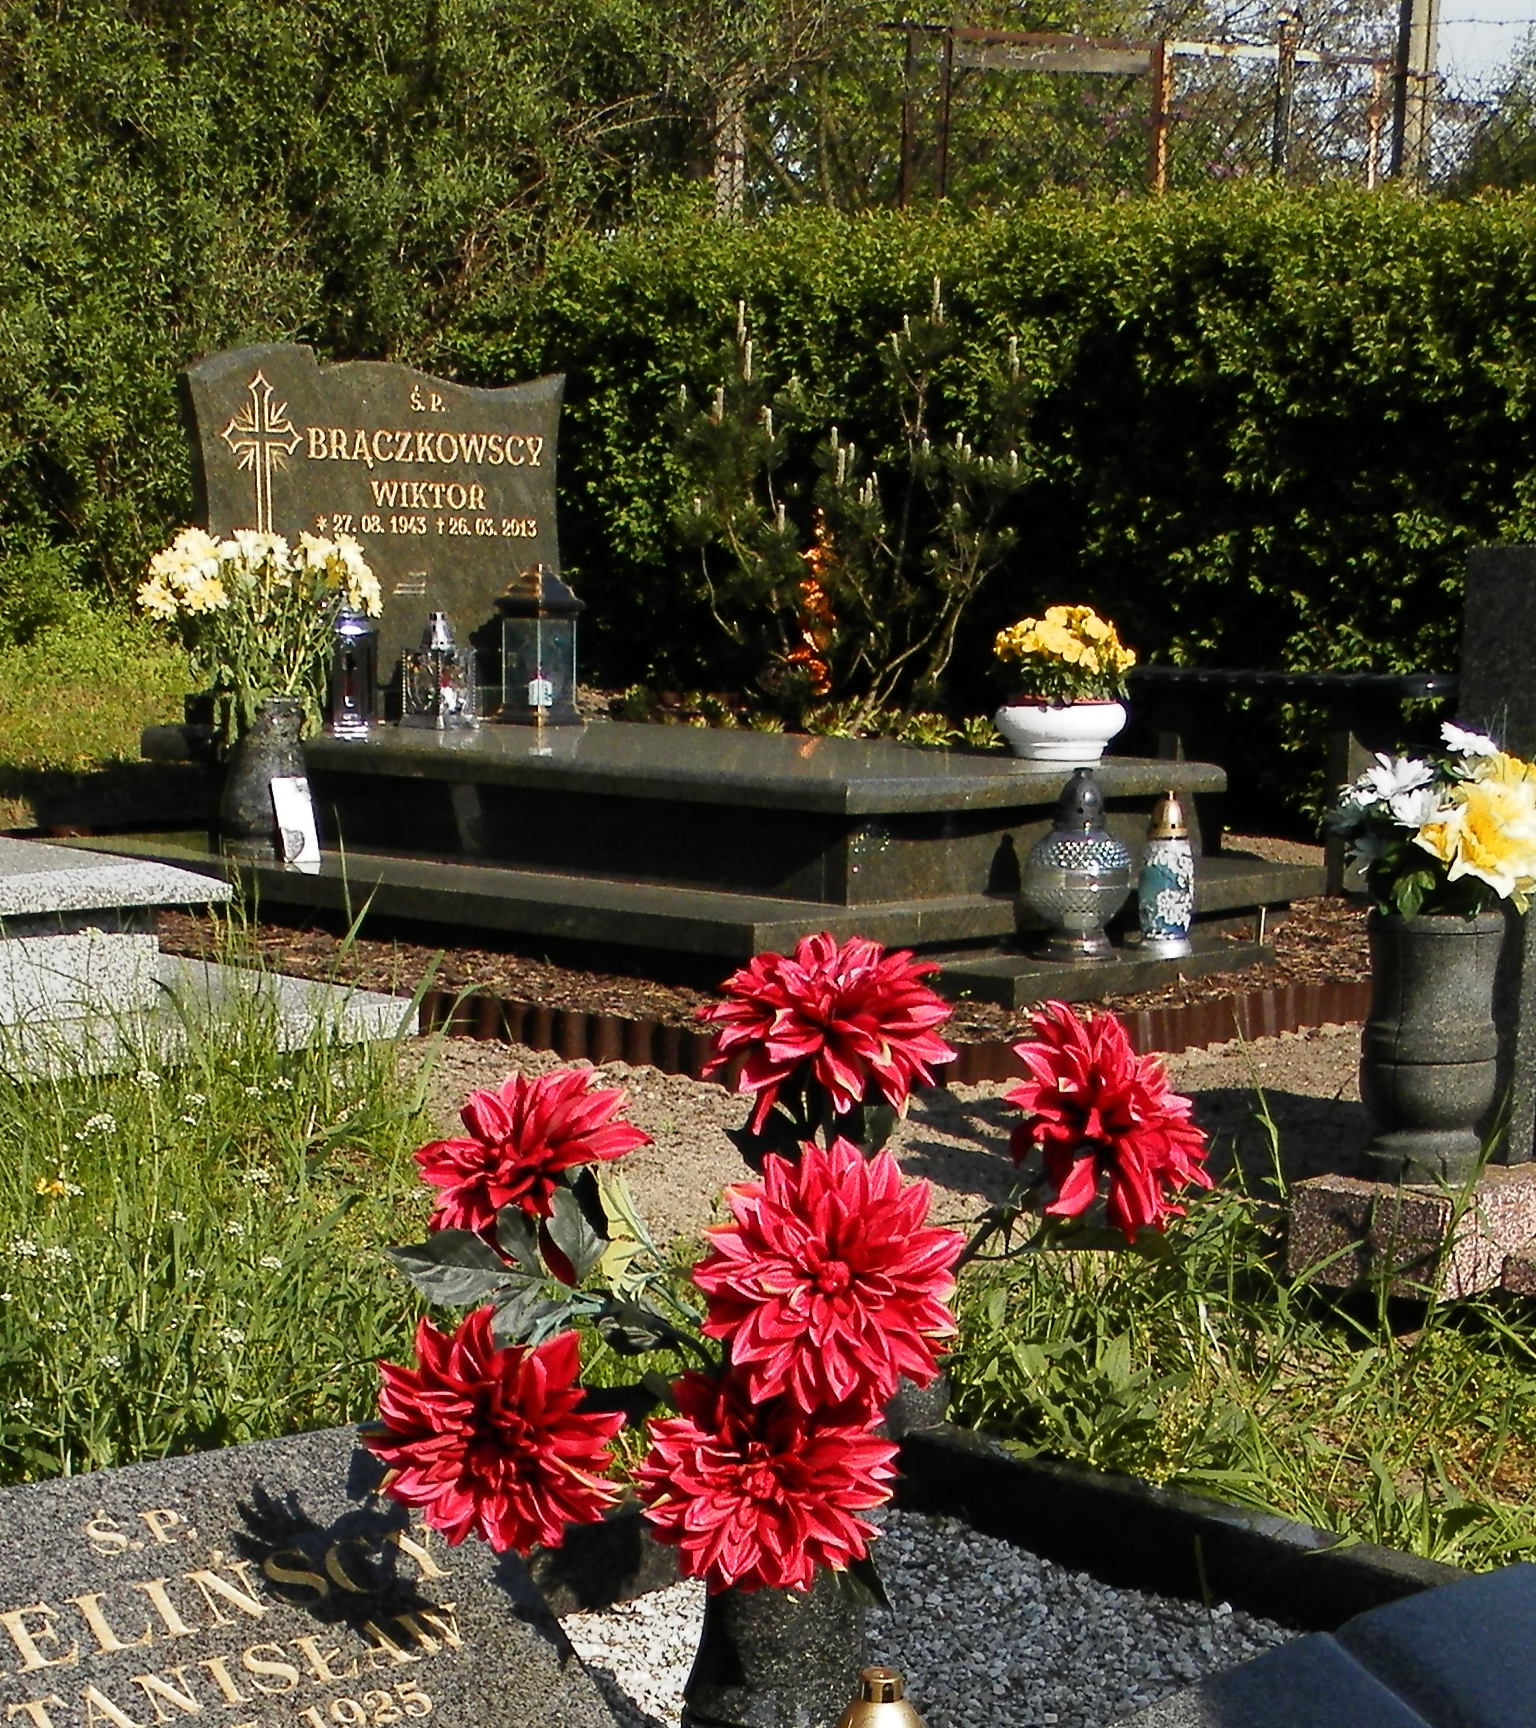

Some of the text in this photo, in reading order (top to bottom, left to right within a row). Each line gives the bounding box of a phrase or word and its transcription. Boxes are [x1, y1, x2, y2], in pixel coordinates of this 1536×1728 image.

[305, 425, 545, 469] BRĄCZKOWSCY
[371, 480, 487, 512] WIKTOR
[501, 518, 538, 538] 2013
